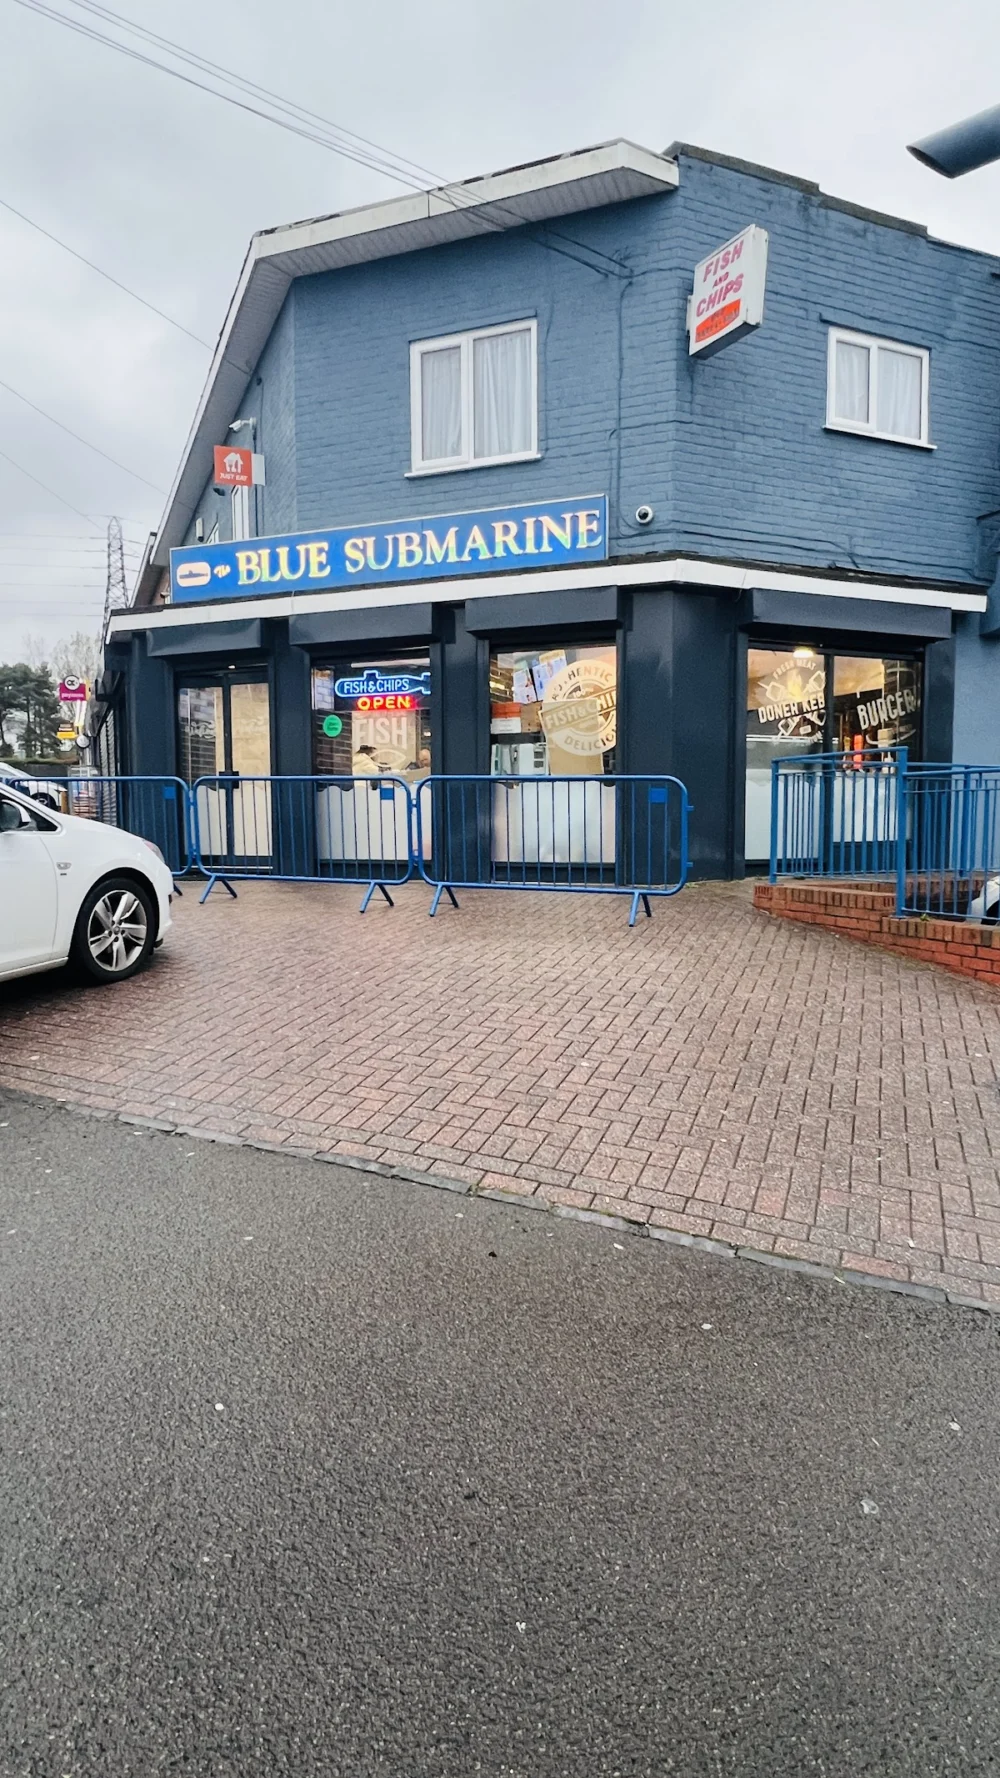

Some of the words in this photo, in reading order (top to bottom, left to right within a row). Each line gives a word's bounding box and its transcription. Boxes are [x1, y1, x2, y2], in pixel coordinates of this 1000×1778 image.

[703, 239, 744, 282] FISH
[712, 271, 730, 289] AND
[696, 273, 744, 317] CHIPS
[219, 472, 235, 480] JUST
[236, 474, 249, 482] EAT
[235, 541, 331, 585] BLUE
[344, 509, 603, 573] SUBMARINE
[357, 695, 411, 711] OPEN
[758, 700, 799, 724] DONER
[857, 689, 915, 730] BURGER
[353, 716, 408, 750] FISH
[564, 729, 616, 751] DELICIO
